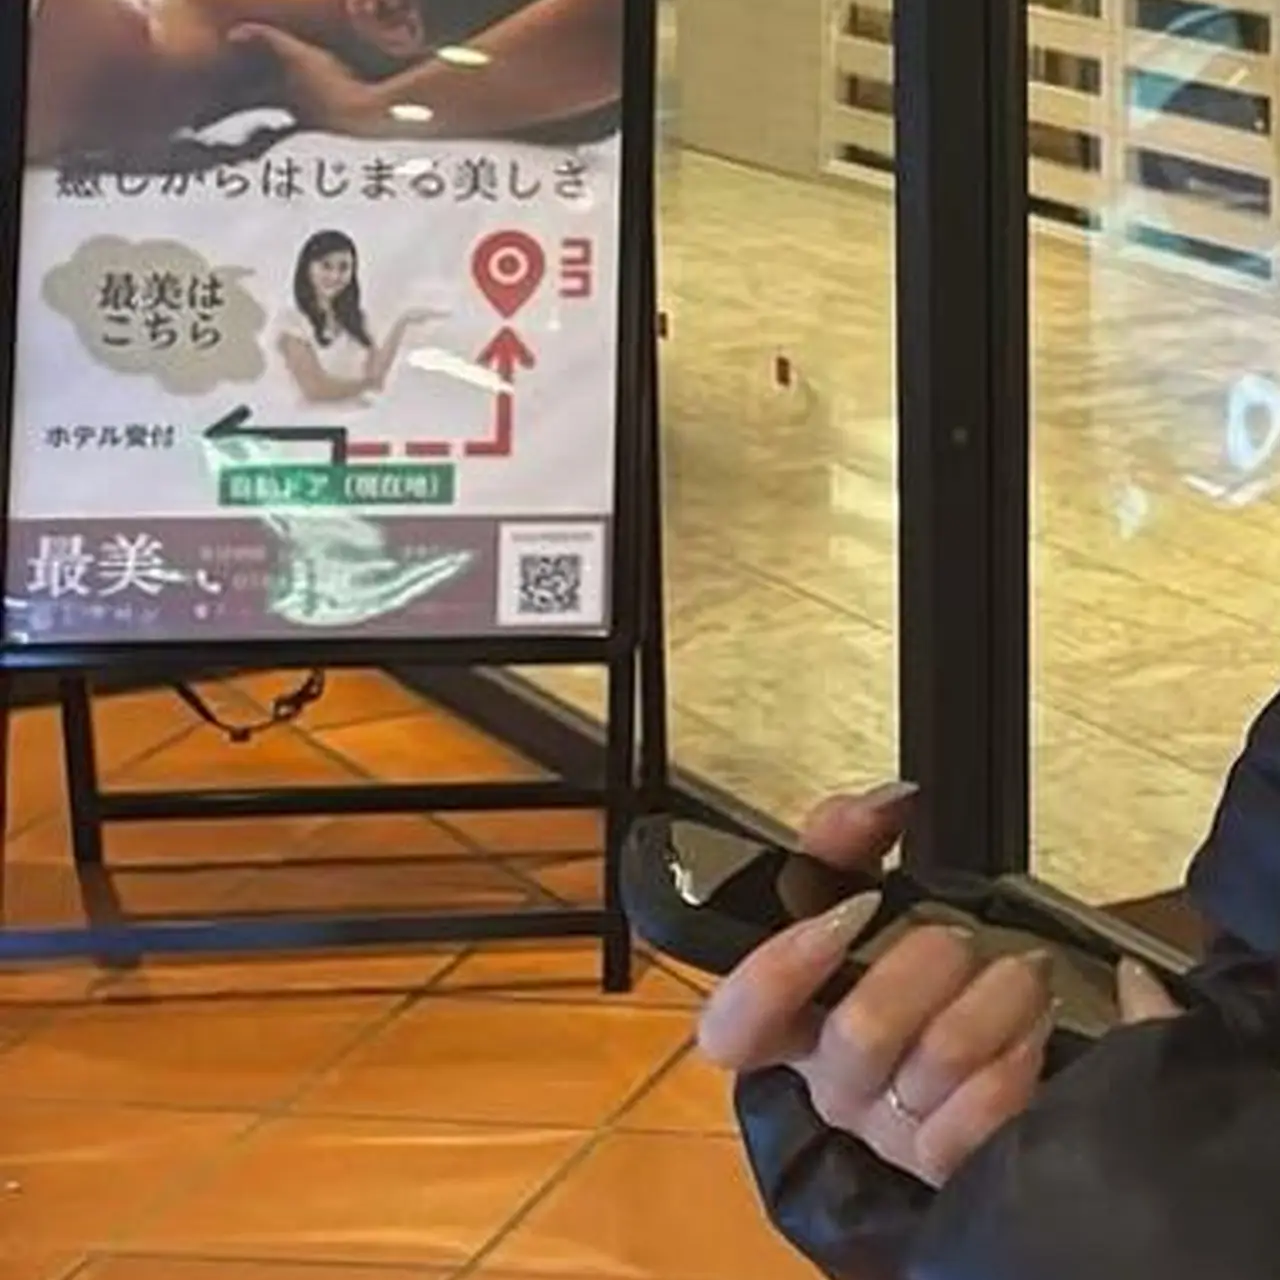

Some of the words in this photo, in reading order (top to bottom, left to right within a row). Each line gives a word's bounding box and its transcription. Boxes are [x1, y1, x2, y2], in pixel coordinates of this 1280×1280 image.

[99, 273, 225, 310] 最美は
[102, 312, 222, 348] こちら
[45, 425, 175, 449] ホテル受付
[27, 533, 167, 598] 最美
